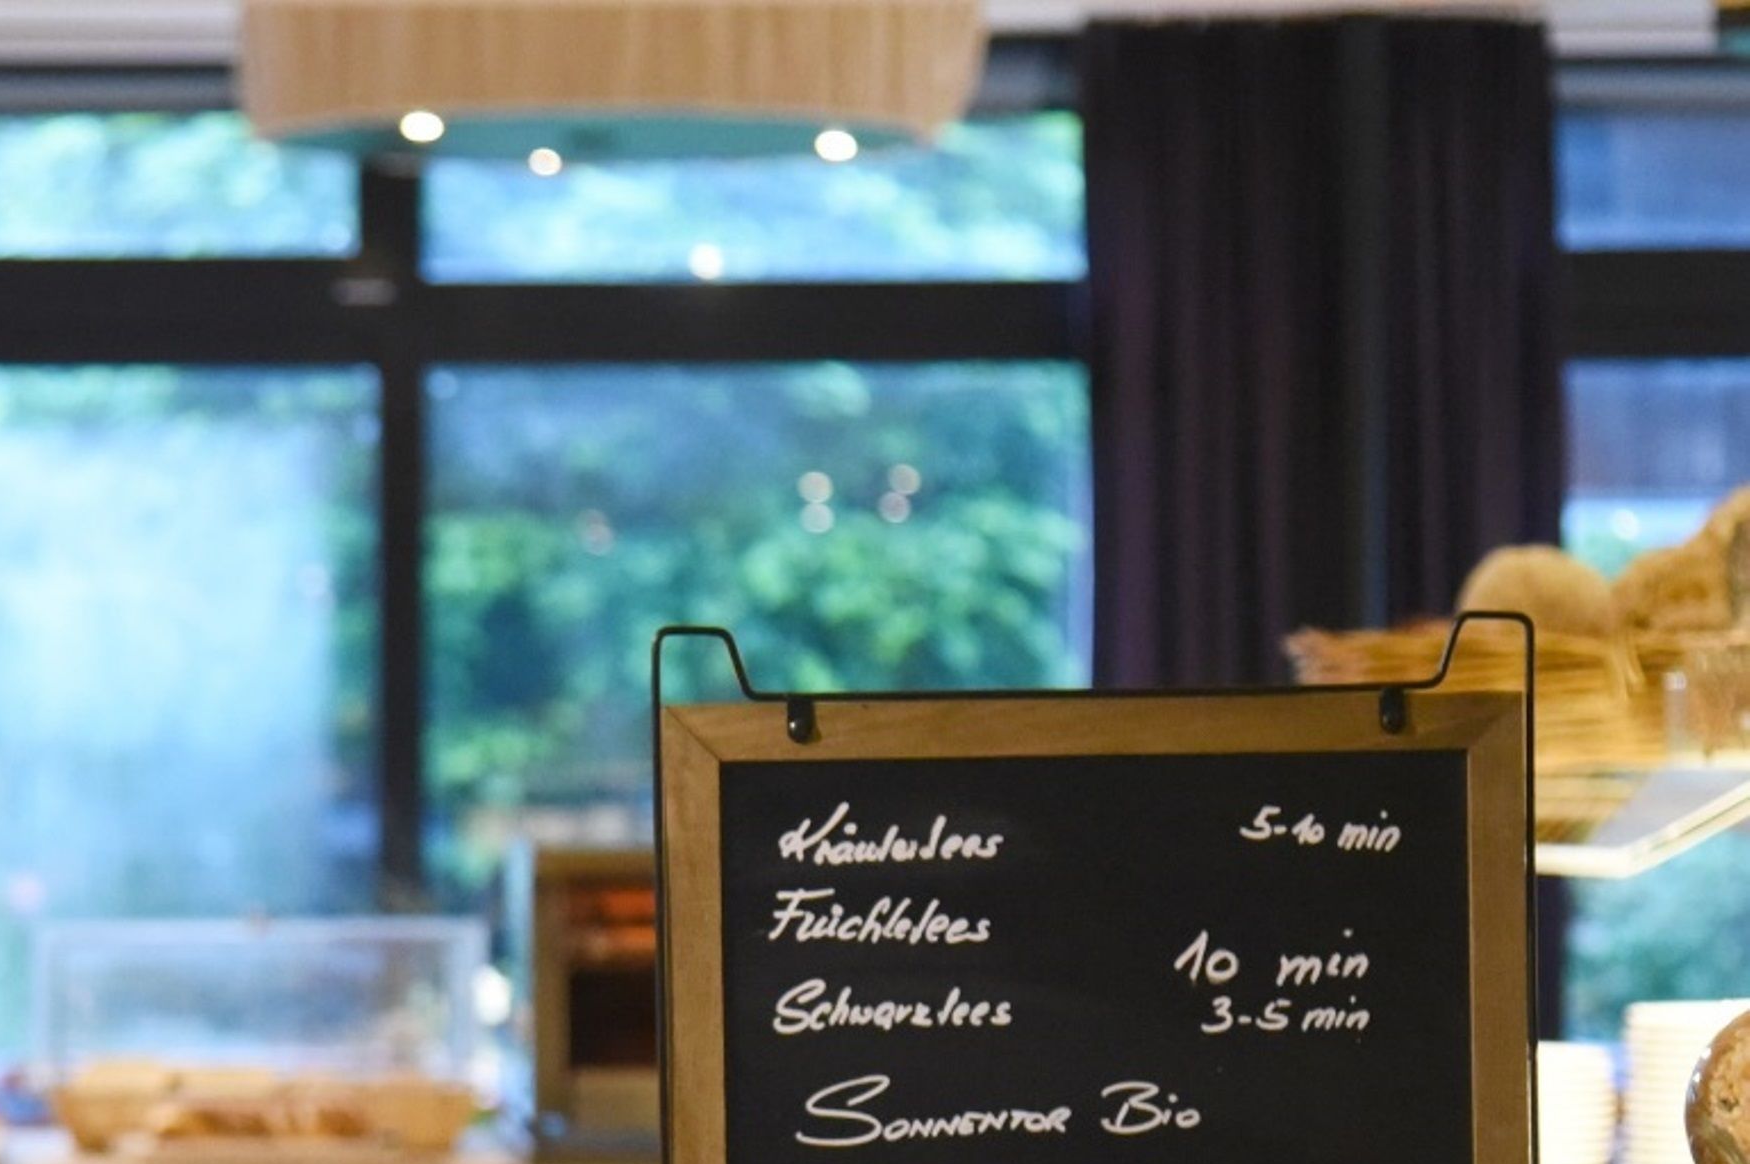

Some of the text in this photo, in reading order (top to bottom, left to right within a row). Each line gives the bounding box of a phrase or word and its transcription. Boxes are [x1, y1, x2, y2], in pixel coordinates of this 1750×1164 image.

[1336, 809, 1402, 852] min
[1173, 928, 1370, 985] 10 min
[772, 977, 1371, 1035] Schwarztees 3-5 min
[795, 1073, 1202, 1147] SONNENTOR Bio
